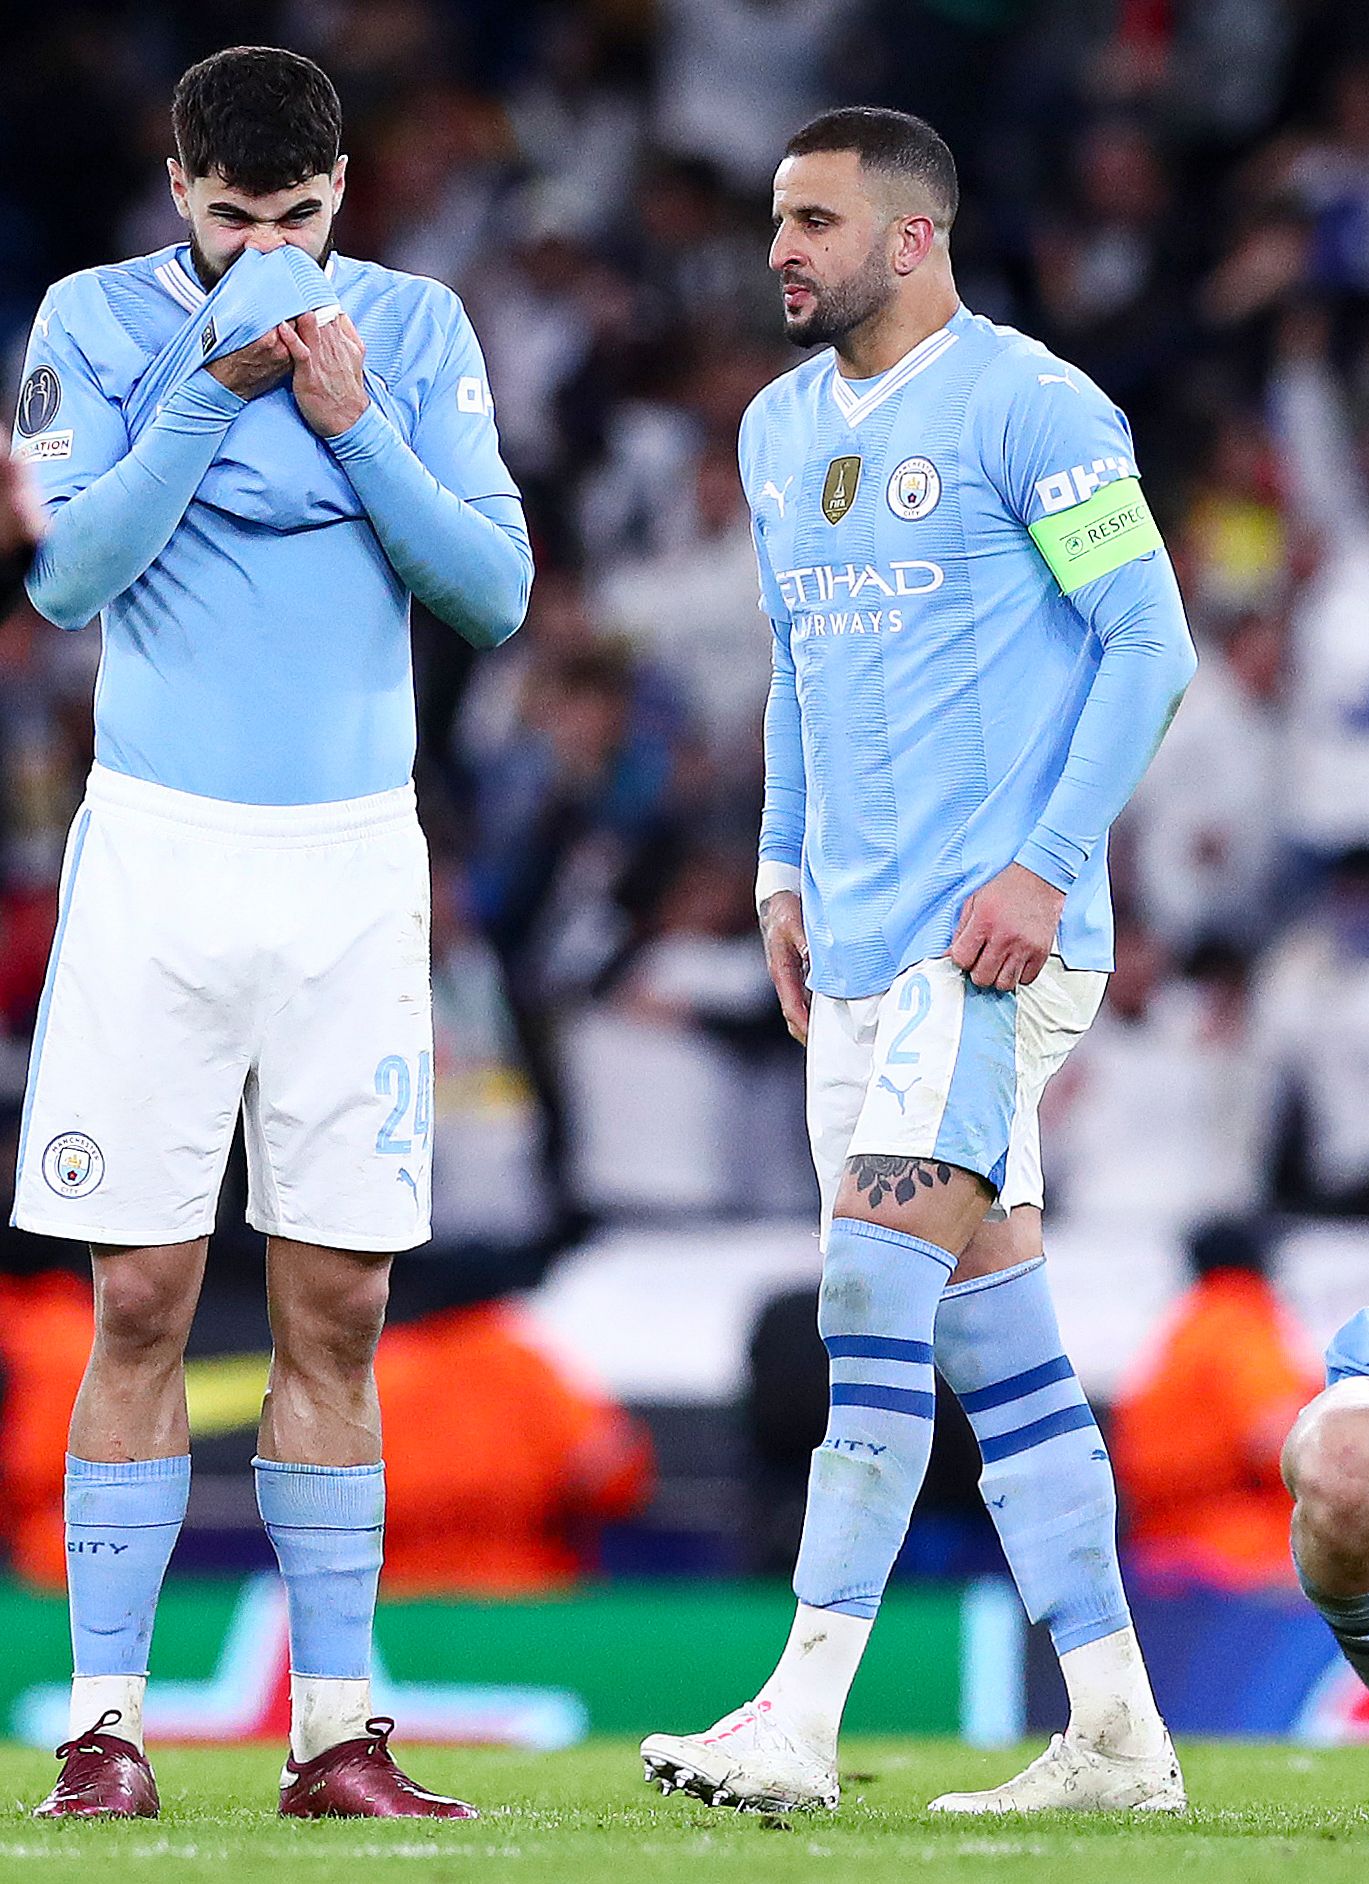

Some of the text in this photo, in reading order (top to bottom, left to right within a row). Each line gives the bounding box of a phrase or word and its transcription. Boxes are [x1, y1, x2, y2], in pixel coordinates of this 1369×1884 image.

[1087, 504, 1146, 544] RESPEC
[885, 973, 931, 1065] 2
[52, 1137, 99, 1160] MANCHESTER
[67, 1541, 129, 1555] CITY
